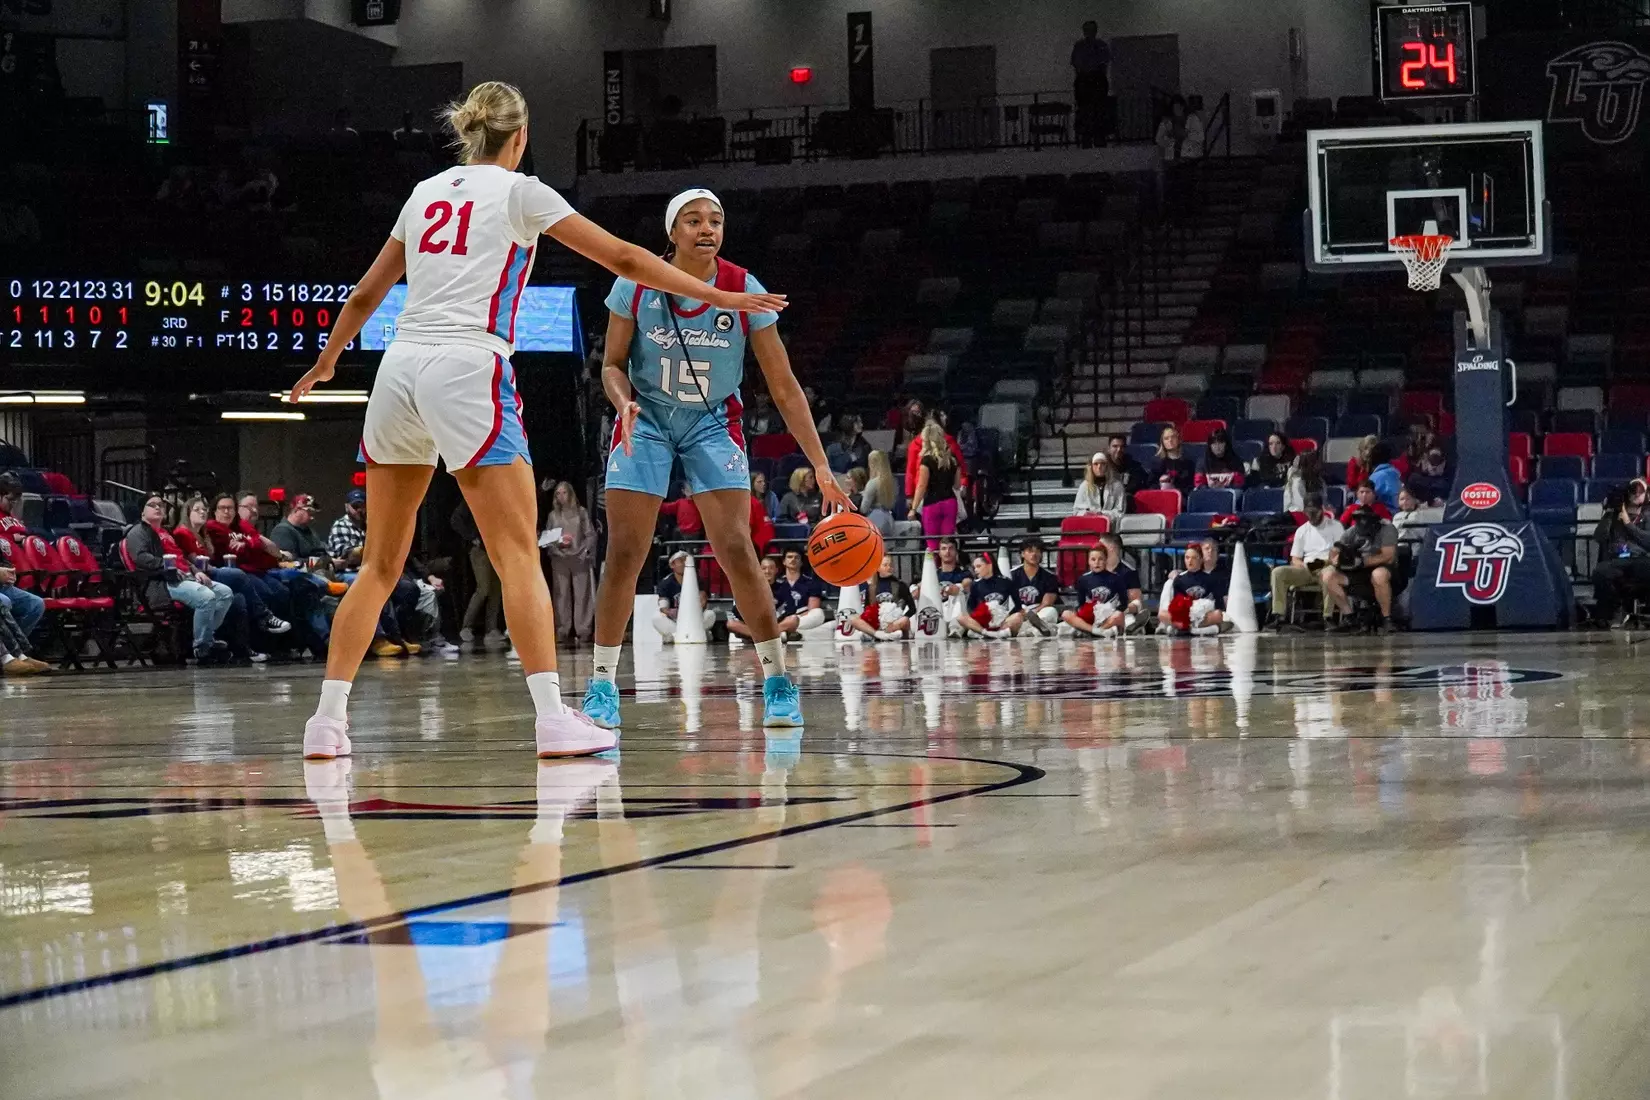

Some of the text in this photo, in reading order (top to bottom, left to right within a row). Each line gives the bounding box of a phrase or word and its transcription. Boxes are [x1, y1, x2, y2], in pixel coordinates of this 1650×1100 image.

[1401, 41, 1457, 88] 24
[607, 68, 621, 125] OMEN
[419, 200, 474, 255] 21
[10, 280, 133, 300] 0 12 21 23 31
[145, 281, 205, 307] 9:04
[241, 284, 253, 301] 3
[262, 284, 283, 301] 15
[288, 284, 309, 302] 18
[312, 285, 334, 302] 22
[12, 305, 128, 325] 1 1 1 0 1
[162, 317, 188, 329] 3RD
[220, 308, 330, 327] F 2 1 0 0
[10, 330, 22, 348] 2
[34, 330, 53, 348] 11
[63, 330, 76, 348] 3
[89, 330, 102, 348] 7
[115, 331, 128, 348] 2
[162, 336, 176, 348] 30
[216, 335, 235, 347] PT
[237, 332, 258, 350] 13
[267, 332, 278, 350] 2
[292, 332, 304, 350] 2
[647, 325, 731, 349] Lady Techsters
[1457, 360, 1499, 372] SPALDING
[660, 357, 710, 403] 15
[1464, 491, 1497, 499] FOSTER
[811, 531, 848, 555] ELITE
[1435, 535, 1514, 605] LU
